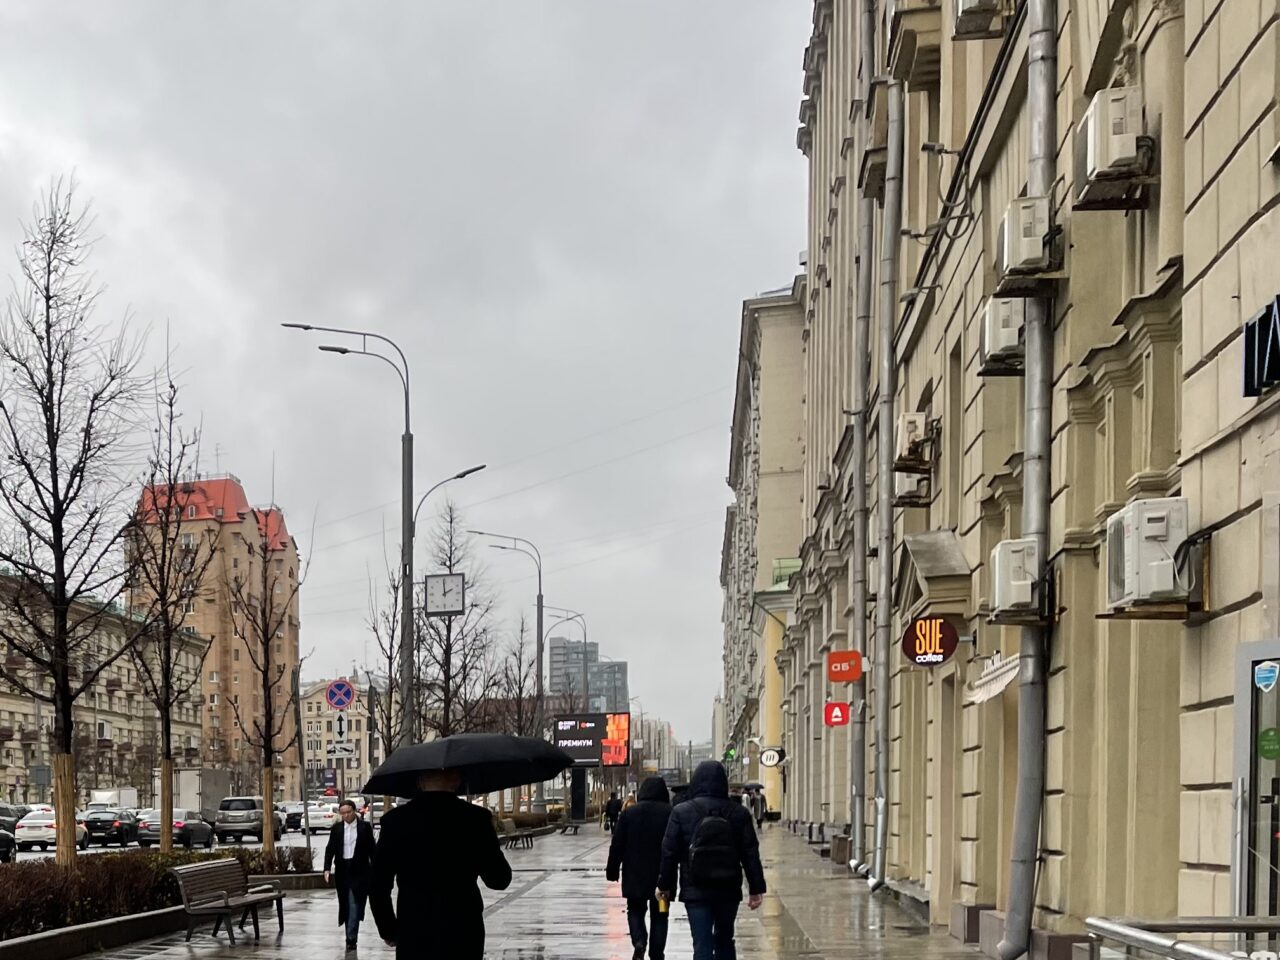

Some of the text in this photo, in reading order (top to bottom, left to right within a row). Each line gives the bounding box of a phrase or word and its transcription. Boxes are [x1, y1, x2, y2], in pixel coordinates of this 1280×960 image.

[915, 619, 944, 655] SUE
[915, 653, 944, 663] coffee
[558, 739, 593, 747] ПРЕМИУМ
